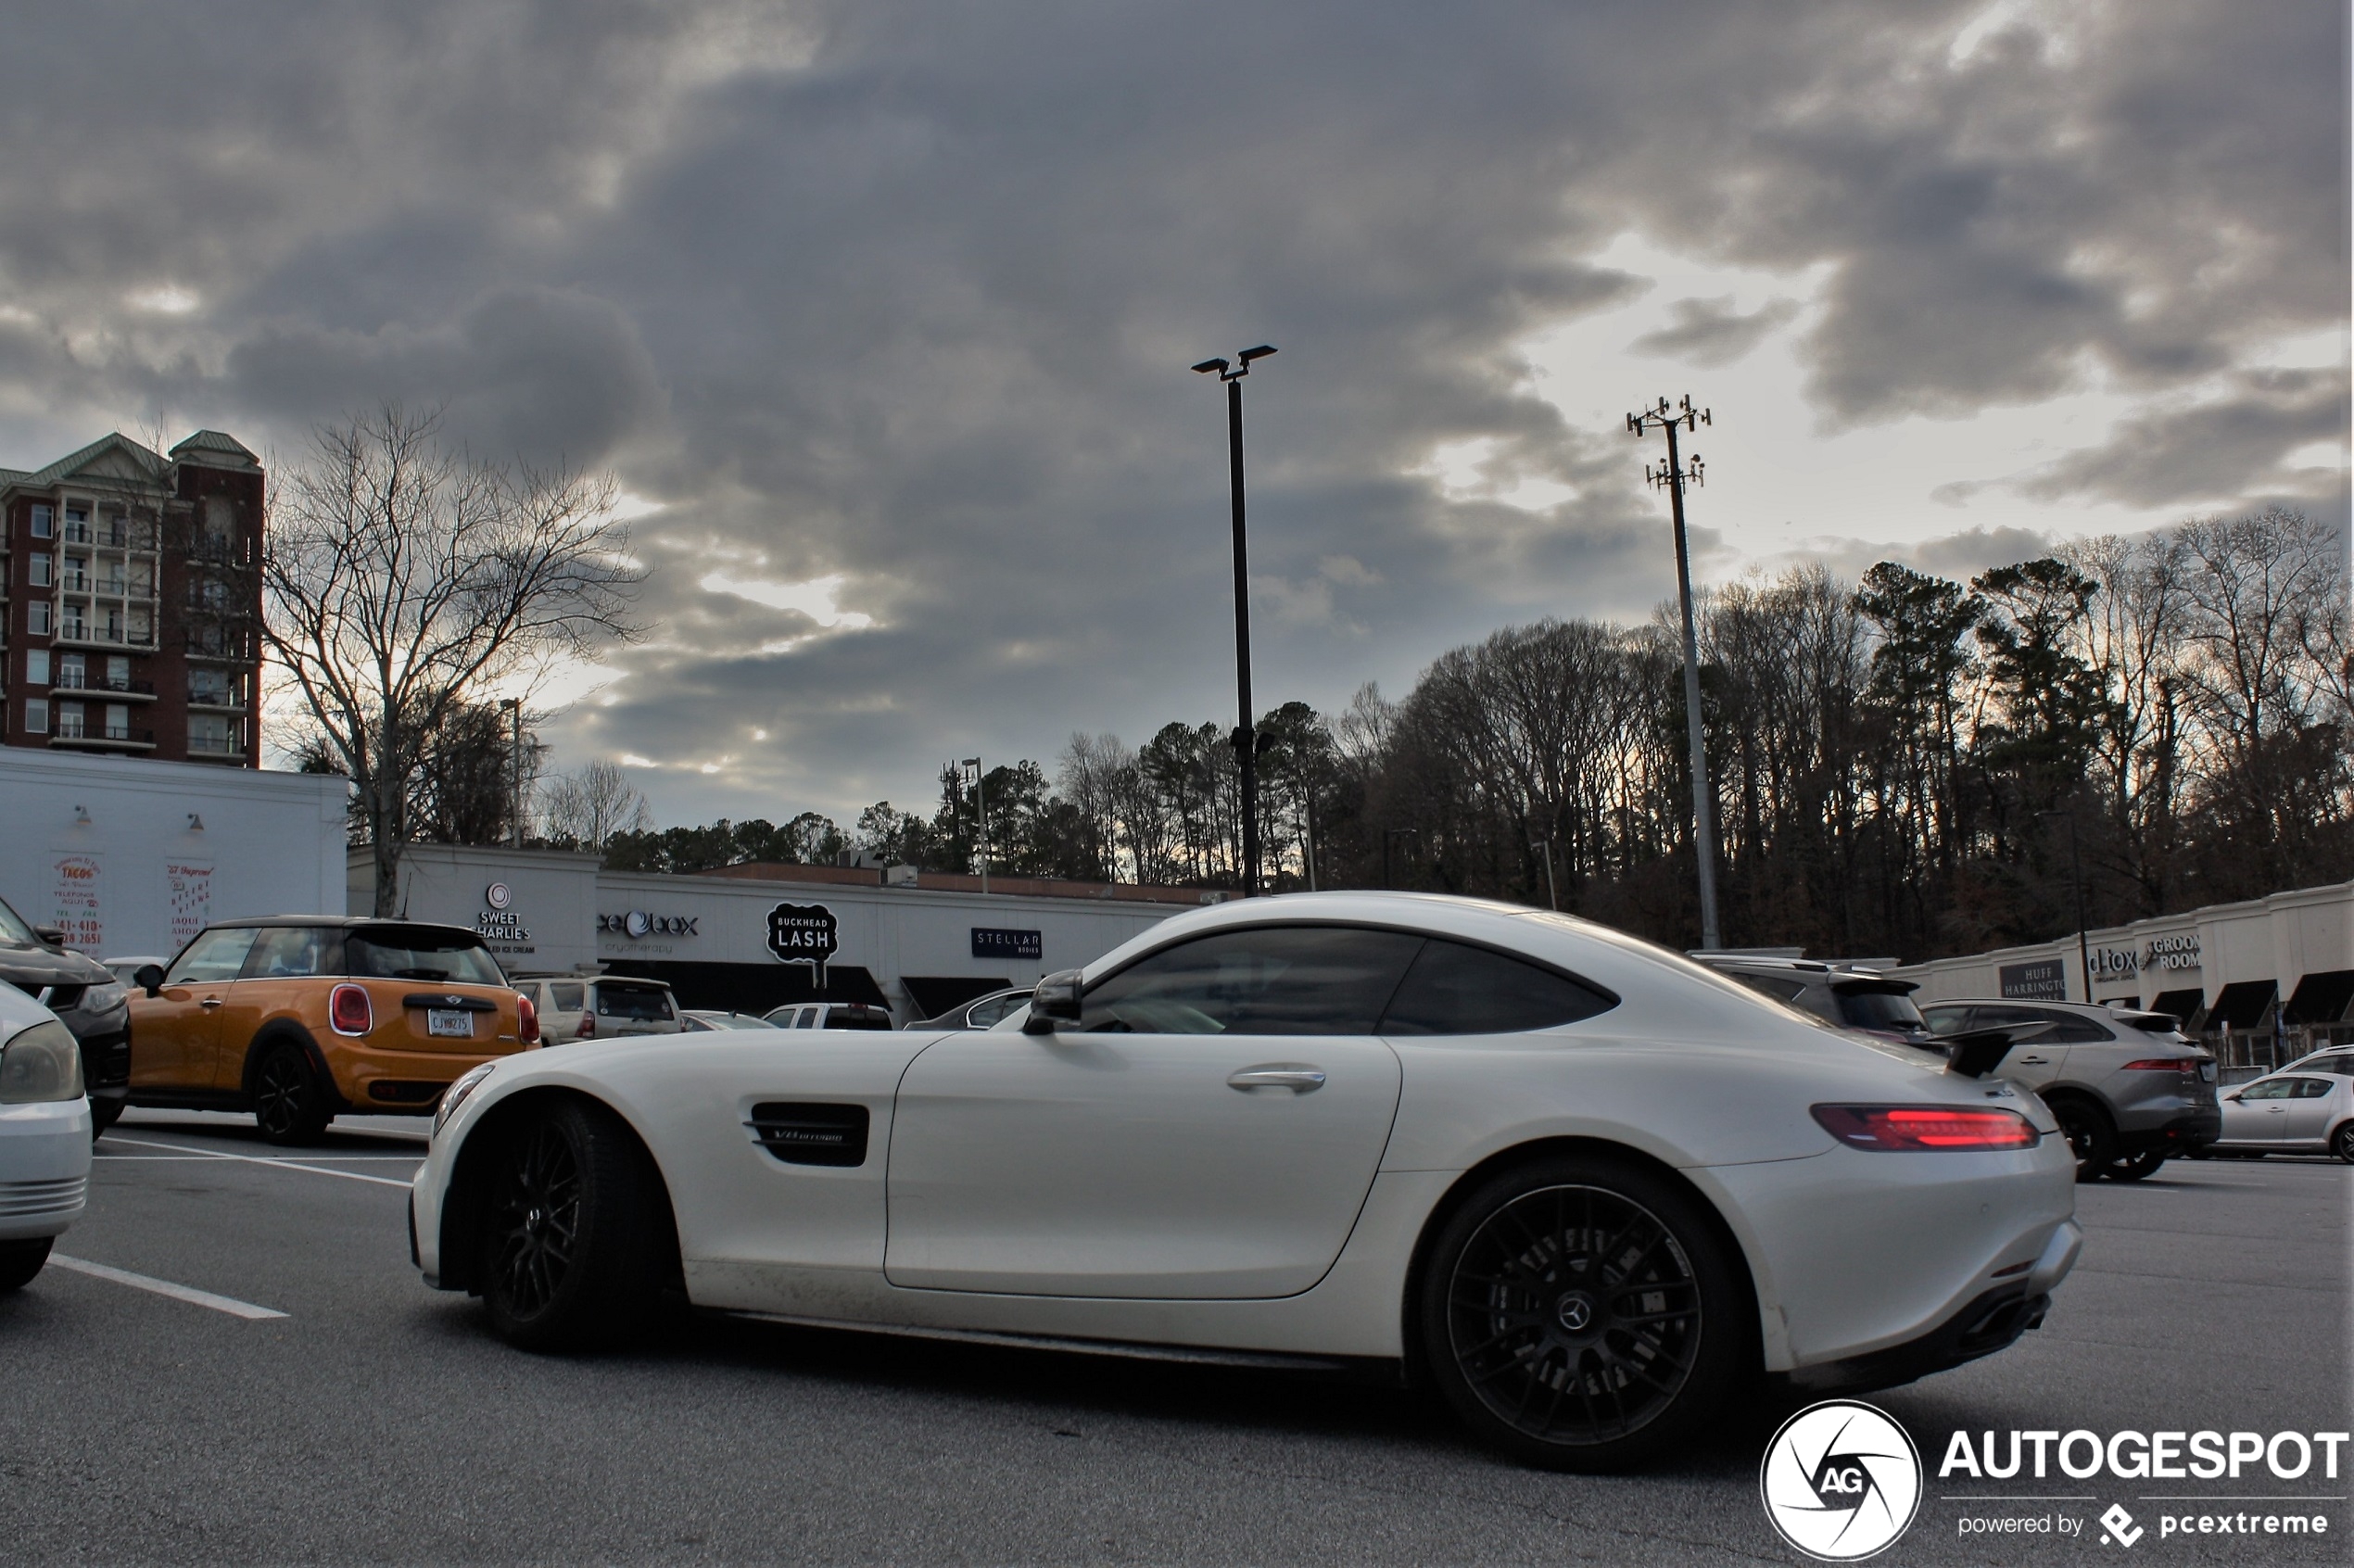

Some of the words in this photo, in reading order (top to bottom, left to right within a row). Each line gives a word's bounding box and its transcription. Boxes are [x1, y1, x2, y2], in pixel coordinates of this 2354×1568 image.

[62, 866, 94, 879] TACOS
[480, 912, 520, 925] SWEET
[778, 917, 828, 928] BUCKHEAD
[778, 929, 829, 947] LASH
[978, 933, 1038, 945] STELLAR
[605, 943, 673, 955] cryotherapy
[2159, 953, 2202, 969] ROOM
[2026, 967, 2052, 980] HUFF
[2095, 975, 2119, 983] ORGANIC
[2120, 973, 2135, 981] JUICE
